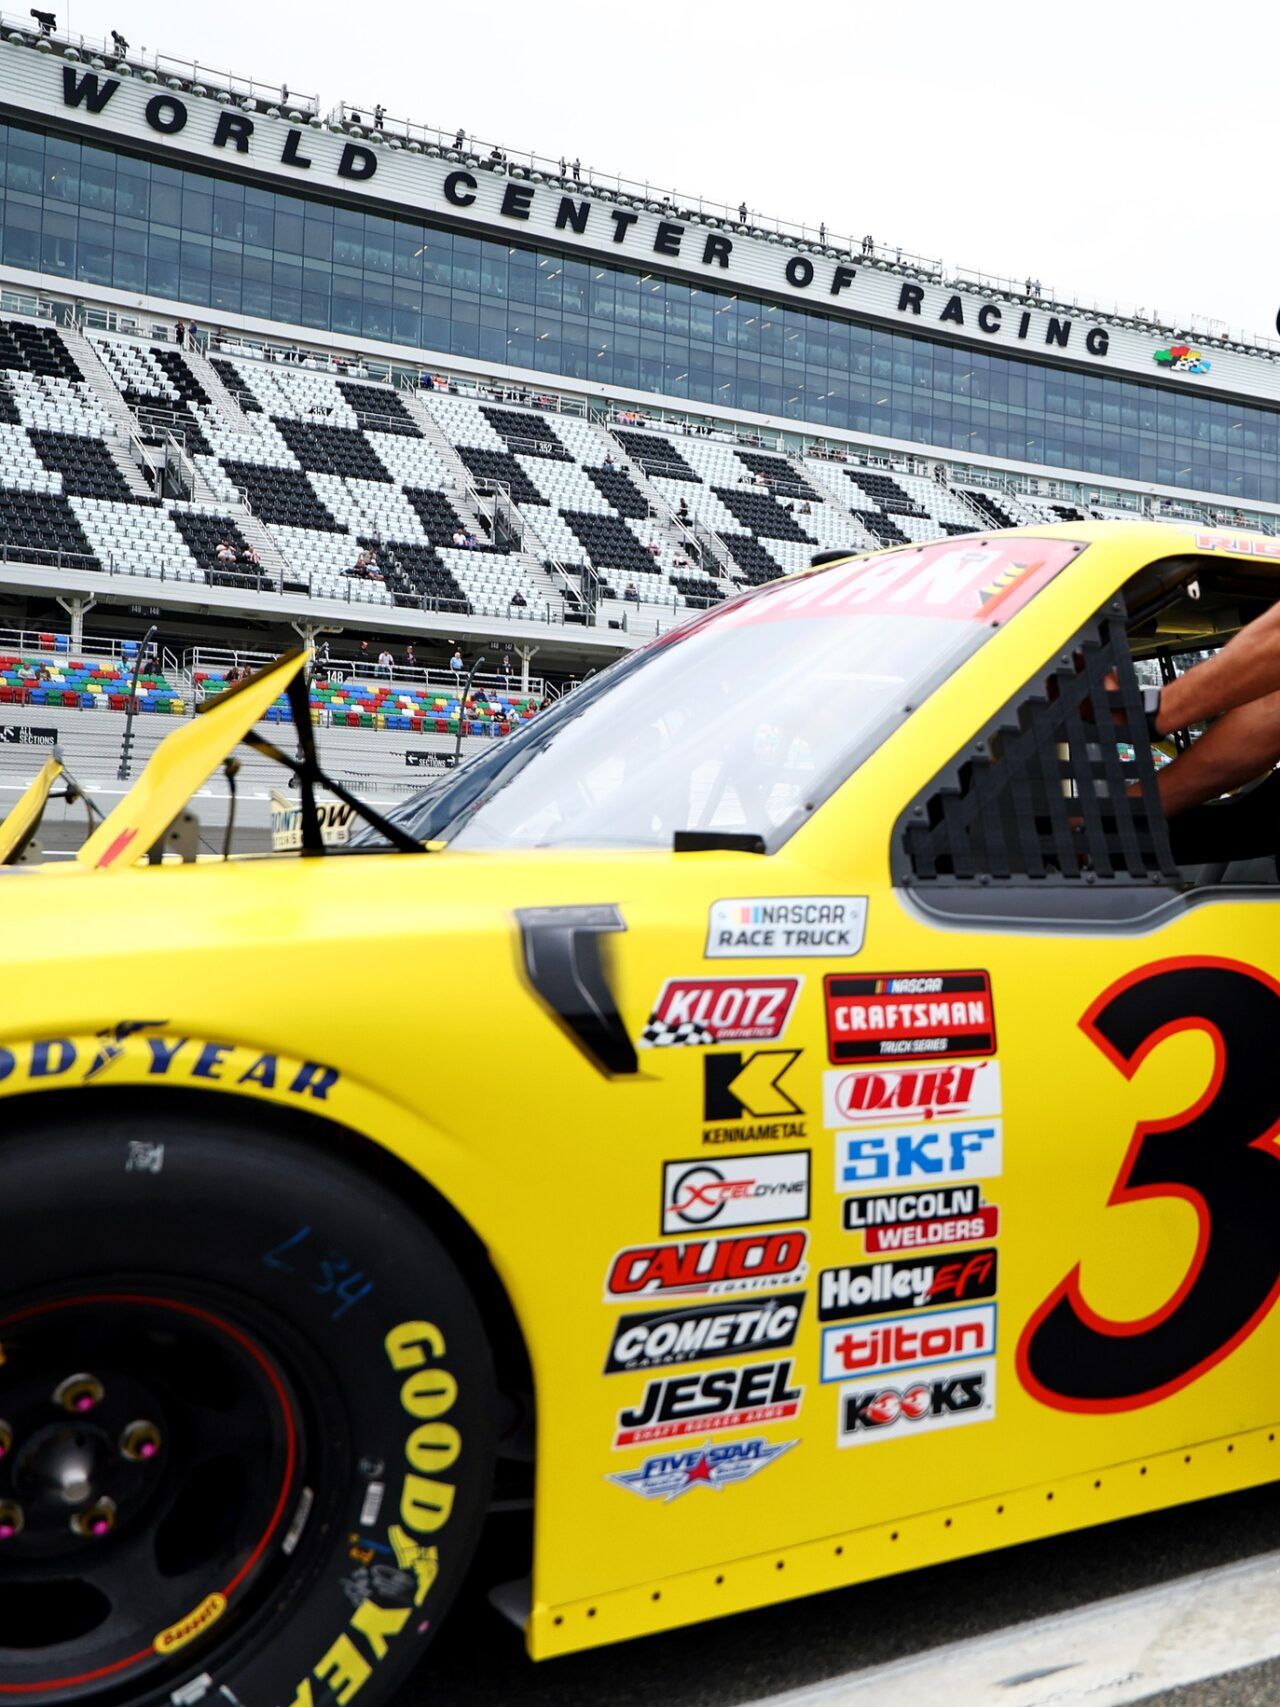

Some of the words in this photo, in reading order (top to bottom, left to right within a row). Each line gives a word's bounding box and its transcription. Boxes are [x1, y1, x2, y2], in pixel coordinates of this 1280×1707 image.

[62, 66, 378, 180] WORLD
[444, 170, 733, 268] CENTER
[785, 256, 857, 296] OF
[899, 282, 1110, 356] RACING
[326, 670, 344, 684] 148
[19, 735, 55, 745] SECTIONS
[761, 903, 847, 924] NASCAR
[717, 929, 775, 948] RACE
[782, 928, 851, 947] TRUCK
[890, 977, 944, 994] NASCAR
[662, 987, 789, 1028] KLOTZ
[834, 1000, 986, 1031] CRAFTSMAN
[879, 1039, 912, 1054] TRUCK
[912, 1037, 949, 1052] SERIES
[847, 1060, 989, 1111] DART
[703, 1122, 807, 1146] KENNAMETAL
[842, 1128, 996, 1182] SKF
[849, 1194, 976, 1228] LINCOLN
[877, 1218, 985, 1251] WELDERS
[608, 1232, 807, 1296] CALICO
[712, 1275, 802, 1294] COATINGS
[822, 1263, 935, 1310] Holley
[613, 1304, 799, 1363] COMETIC
[835, 1322, 984, 1371] tilton
[620, 1362, 801, 1428] JESEL
[843, 1371, 987, 1433] KOOKS
[643, 1452, 700, 1479] FIVE
[709, 1440, 763, 1462] STAR
